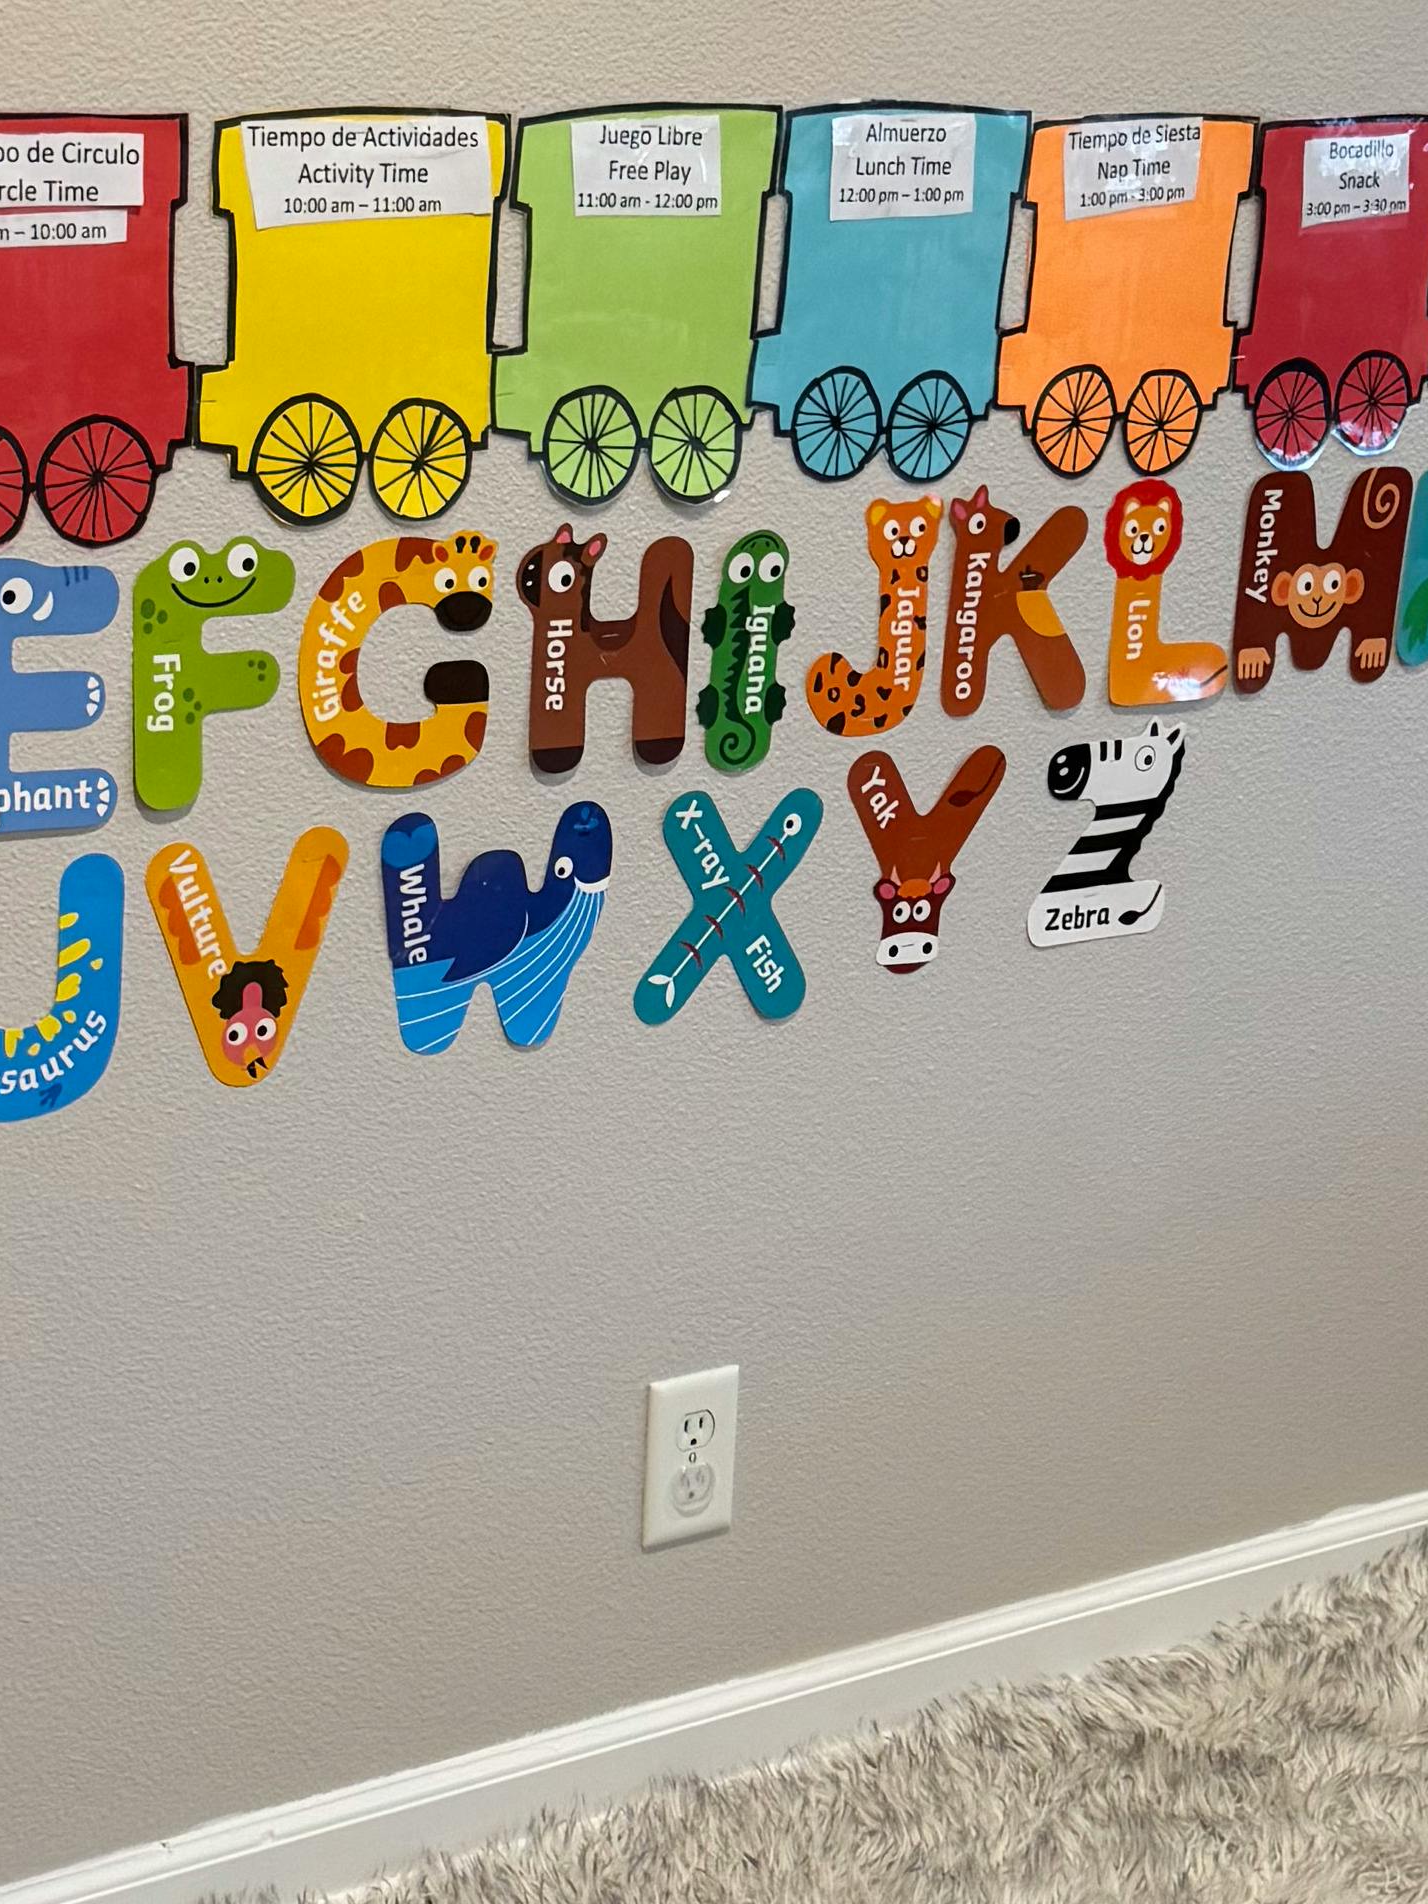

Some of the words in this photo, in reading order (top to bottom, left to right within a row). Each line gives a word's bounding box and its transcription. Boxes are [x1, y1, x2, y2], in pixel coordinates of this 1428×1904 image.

[247, 125, 325, 152] Tiempo
[332, 125, 357, 147] de
[362, 125, 479, 148] Actividades
[599, 125, 652, 150] Juego
[657, 125, 703, 147] Libre
[866, 123, 947, 144] Almuerzo
[1068, 131, 1128, 152] Tiempo
[1132, 126, 1151, 145] de
[1156, 124, 1201, 143] Siesta
[27, 140, 54, 164] de
[62, 142, 139, 165] Circulo
[1329, 139, 1394, 160] Bocadillo
[298, 163, 375, 188] Activity
[379, 163, 429, 183] Time
[609, 161, 648, 181] Free
[654, 160, 692, 186] Play
[855, 157, 906, 177] Lunch
[910, 157, 952, 177] Time
[1098, 162, 1128, 182] Nap
[1133, 159, 1171, 176] Time
[43, 180, 99, 202] Time
[1339, 171, 1380, 190] Snack
[284, 197, 327, 214] 10:00
[331, 200, 354, 213] am
[373, 197, 415, 213] 11:00
[419, 199, 442, 211] am
[577, 193, 617, 209] 11:00
[620, 196, 642, 209] am
[655, 193, 693, 210] 12:00
[696, 197, 718, 213] pm
[839, 188, 876, 204] 12:00
[878, 191, 899, 206] pm
[913, 187, 940, 202] 1:00
[943, 190, 964, 204] pm
[1080, 192, 1106, 207] 1:00
[1109, 193, 1128, 208] pm
[1166, 187, 1185, 201] pm
[1307, 202, 1331, 216] 3:00
[1334, 203, 1351, 217] pm
[31, 223, 77, 240] 10:00
[82, 225, 107, 239] am
[1245, 489, 1283, 604] Monkey
[890, 586, 920, 692] Jaguar
[955, 552, 991, 700] Kangaroo
[1126, 599, 1151, 661] Lion
[313, 591, 366, 723] Giraffe
[545, 618, 573, 711] Horse
[744, 604, 776, 715] Iguana
[146, 653, 181, 733] Frog
[860, 766, 896, 829] Yak
[676, 800, 729, 890] X-ray
[745, 934, 783, 994] Fish
[169, 849, 228, 980] Vulture
[400, 863, 428, 964] Whale
[1044, 904, 1110, 932] Zebra
